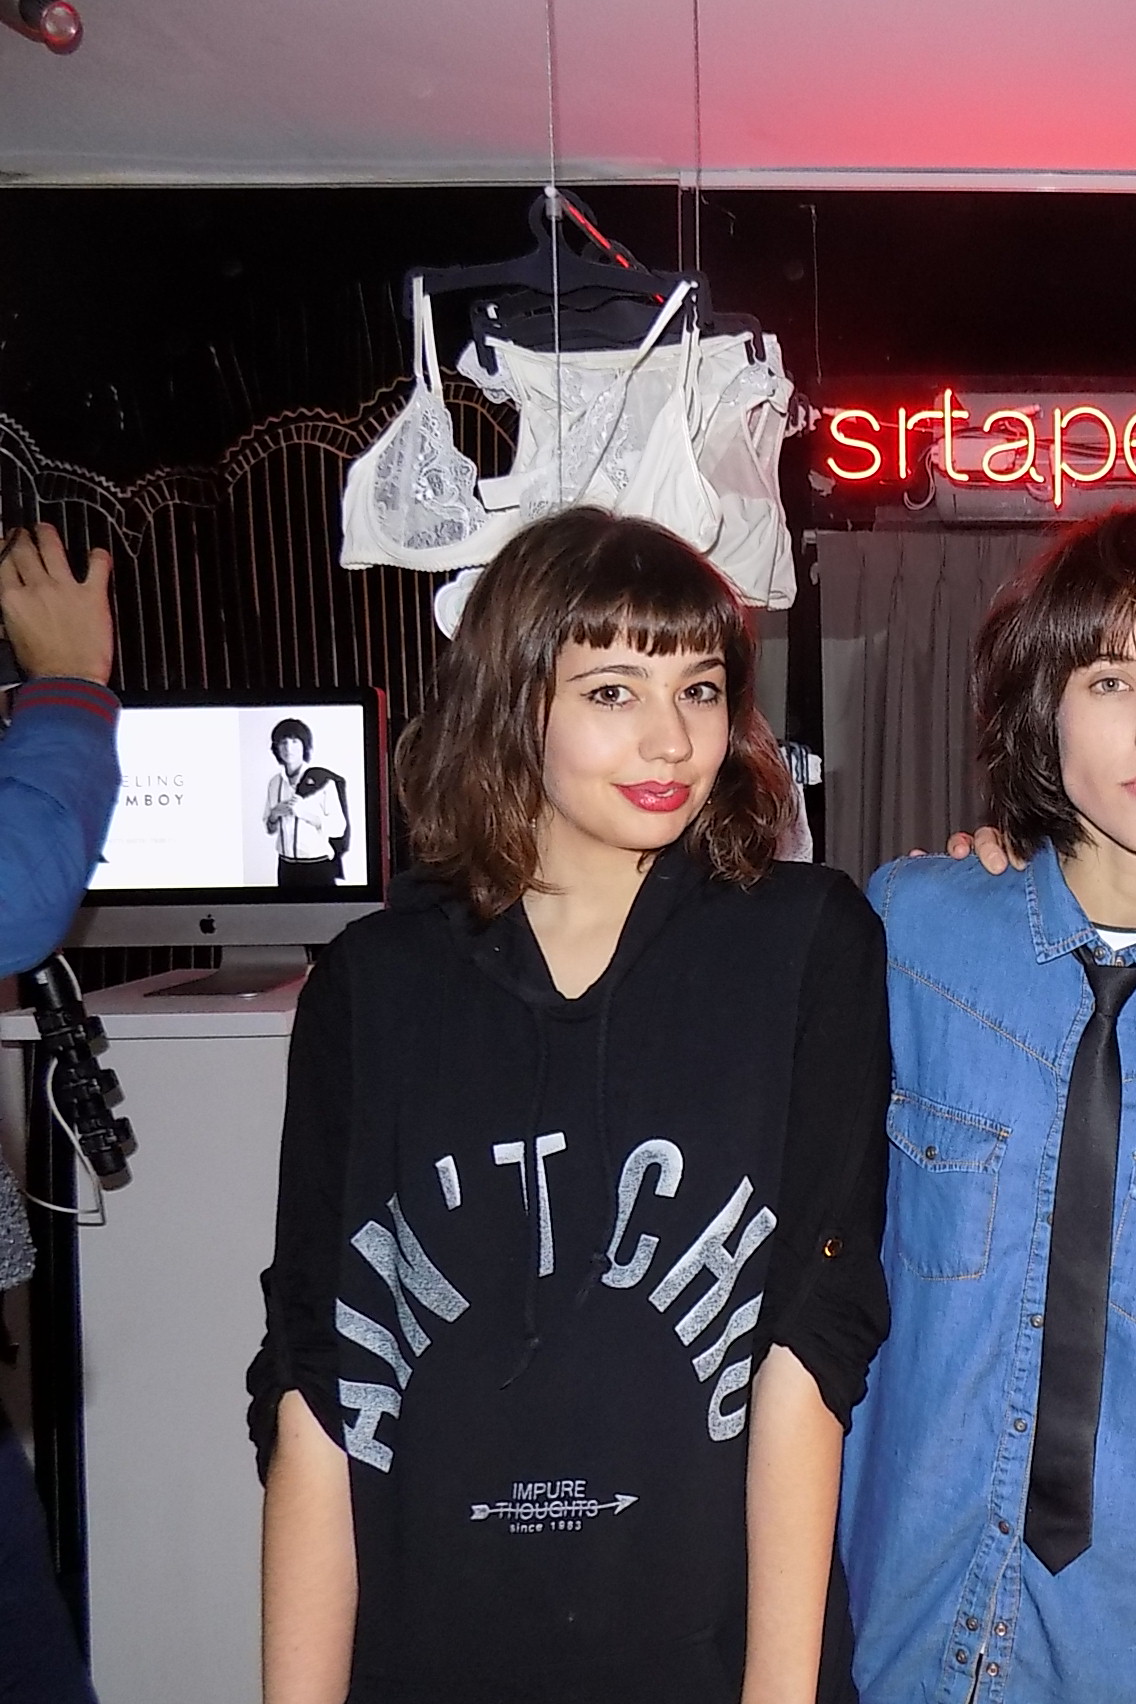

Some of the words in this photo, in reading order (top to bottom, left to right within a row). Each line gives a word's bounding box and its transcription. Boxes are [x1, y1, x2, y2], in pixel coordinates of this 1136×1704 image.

[512, 1480, 586, 1500] IMPURE
[496, 1500, 599, 1520] THOUGHTS
[509, 1521, 544, 1533] since
